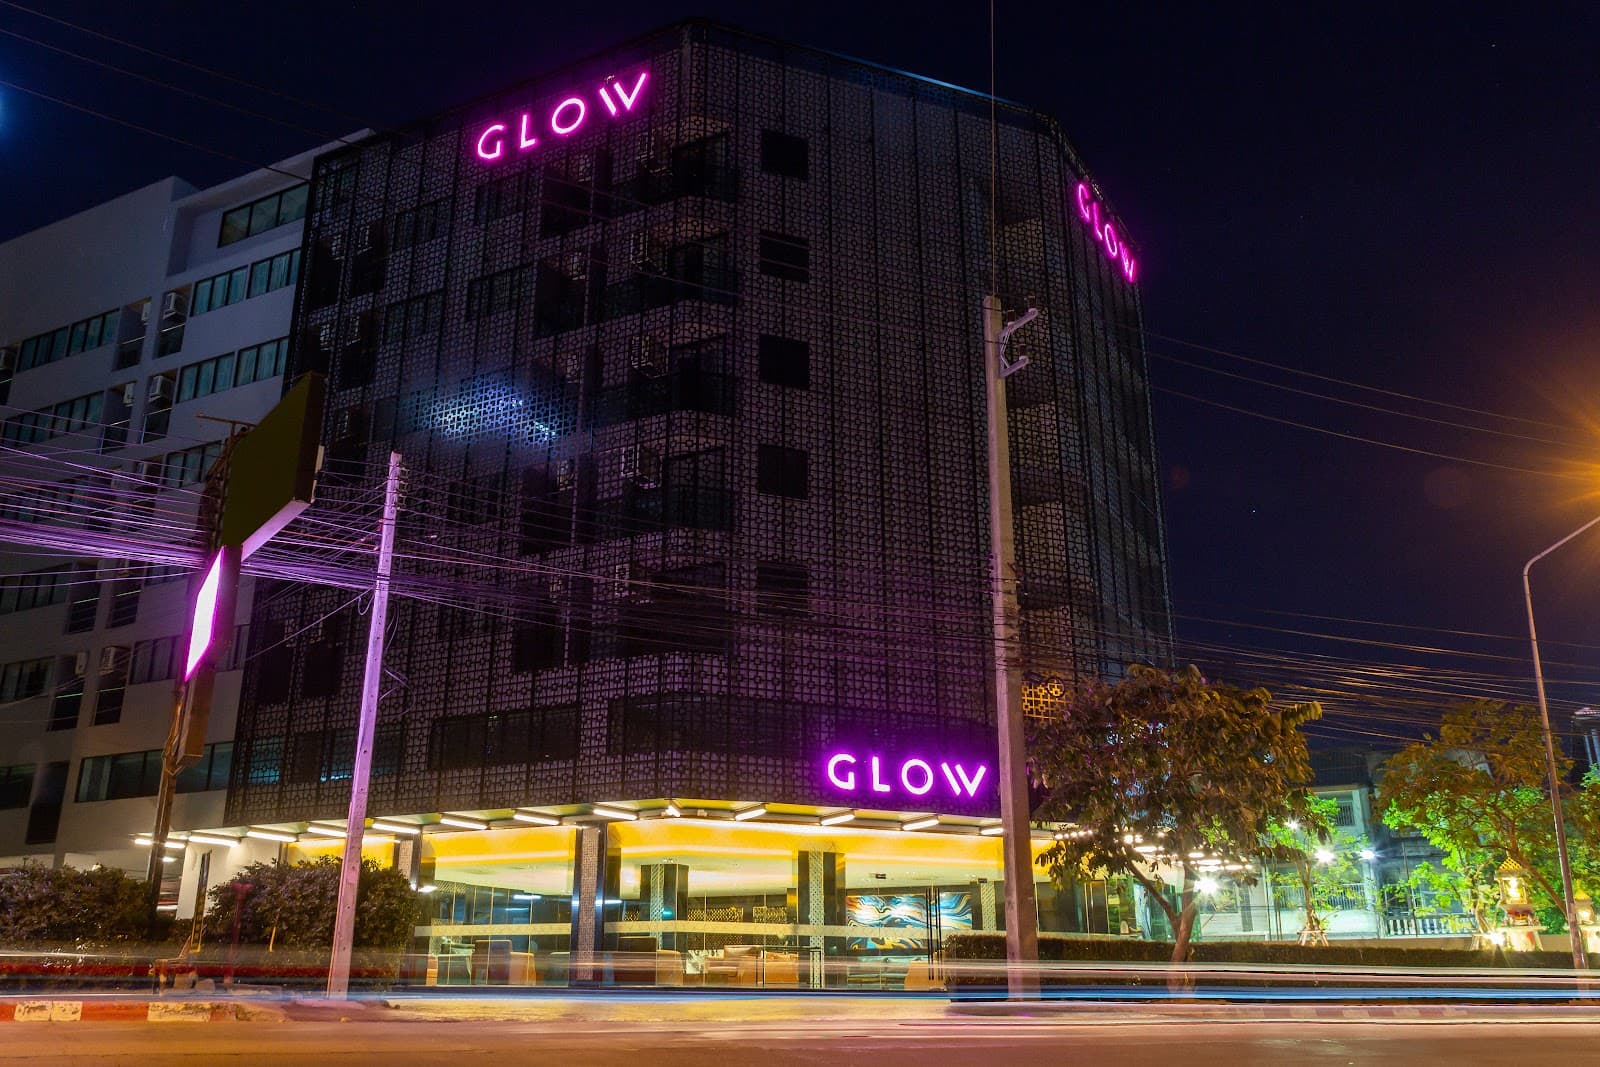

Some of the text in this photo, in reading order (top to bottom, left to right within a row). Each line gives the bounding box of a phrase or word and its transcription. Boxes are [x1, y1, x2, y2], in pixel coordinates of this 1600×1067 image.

[476, 71, 649, 161] GLOW
[1077, 183, 1137, 283] GLOW
[826, 752, 987, 798] GLOW
